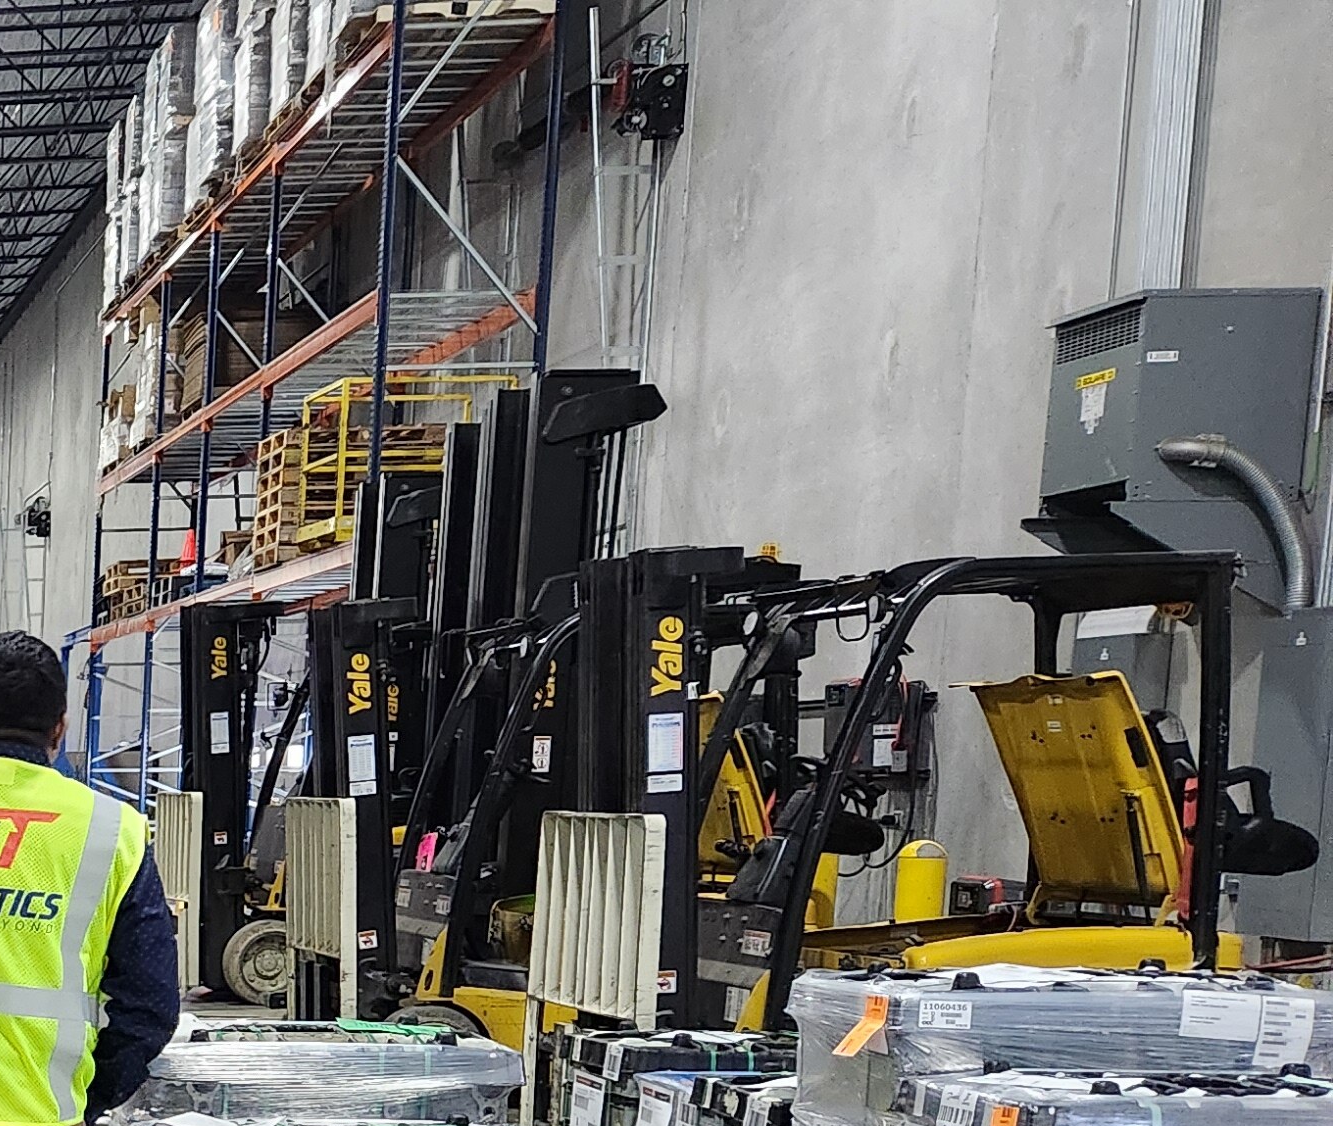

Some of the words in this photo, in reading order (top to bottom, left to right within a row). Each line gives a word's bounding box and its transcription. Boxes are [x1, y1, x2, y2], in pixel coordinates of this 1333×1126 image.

[210, 635, 228, 681] Yale
[346, 652, 372, 715] Yale
[650, 615, 684, 698] Yale
